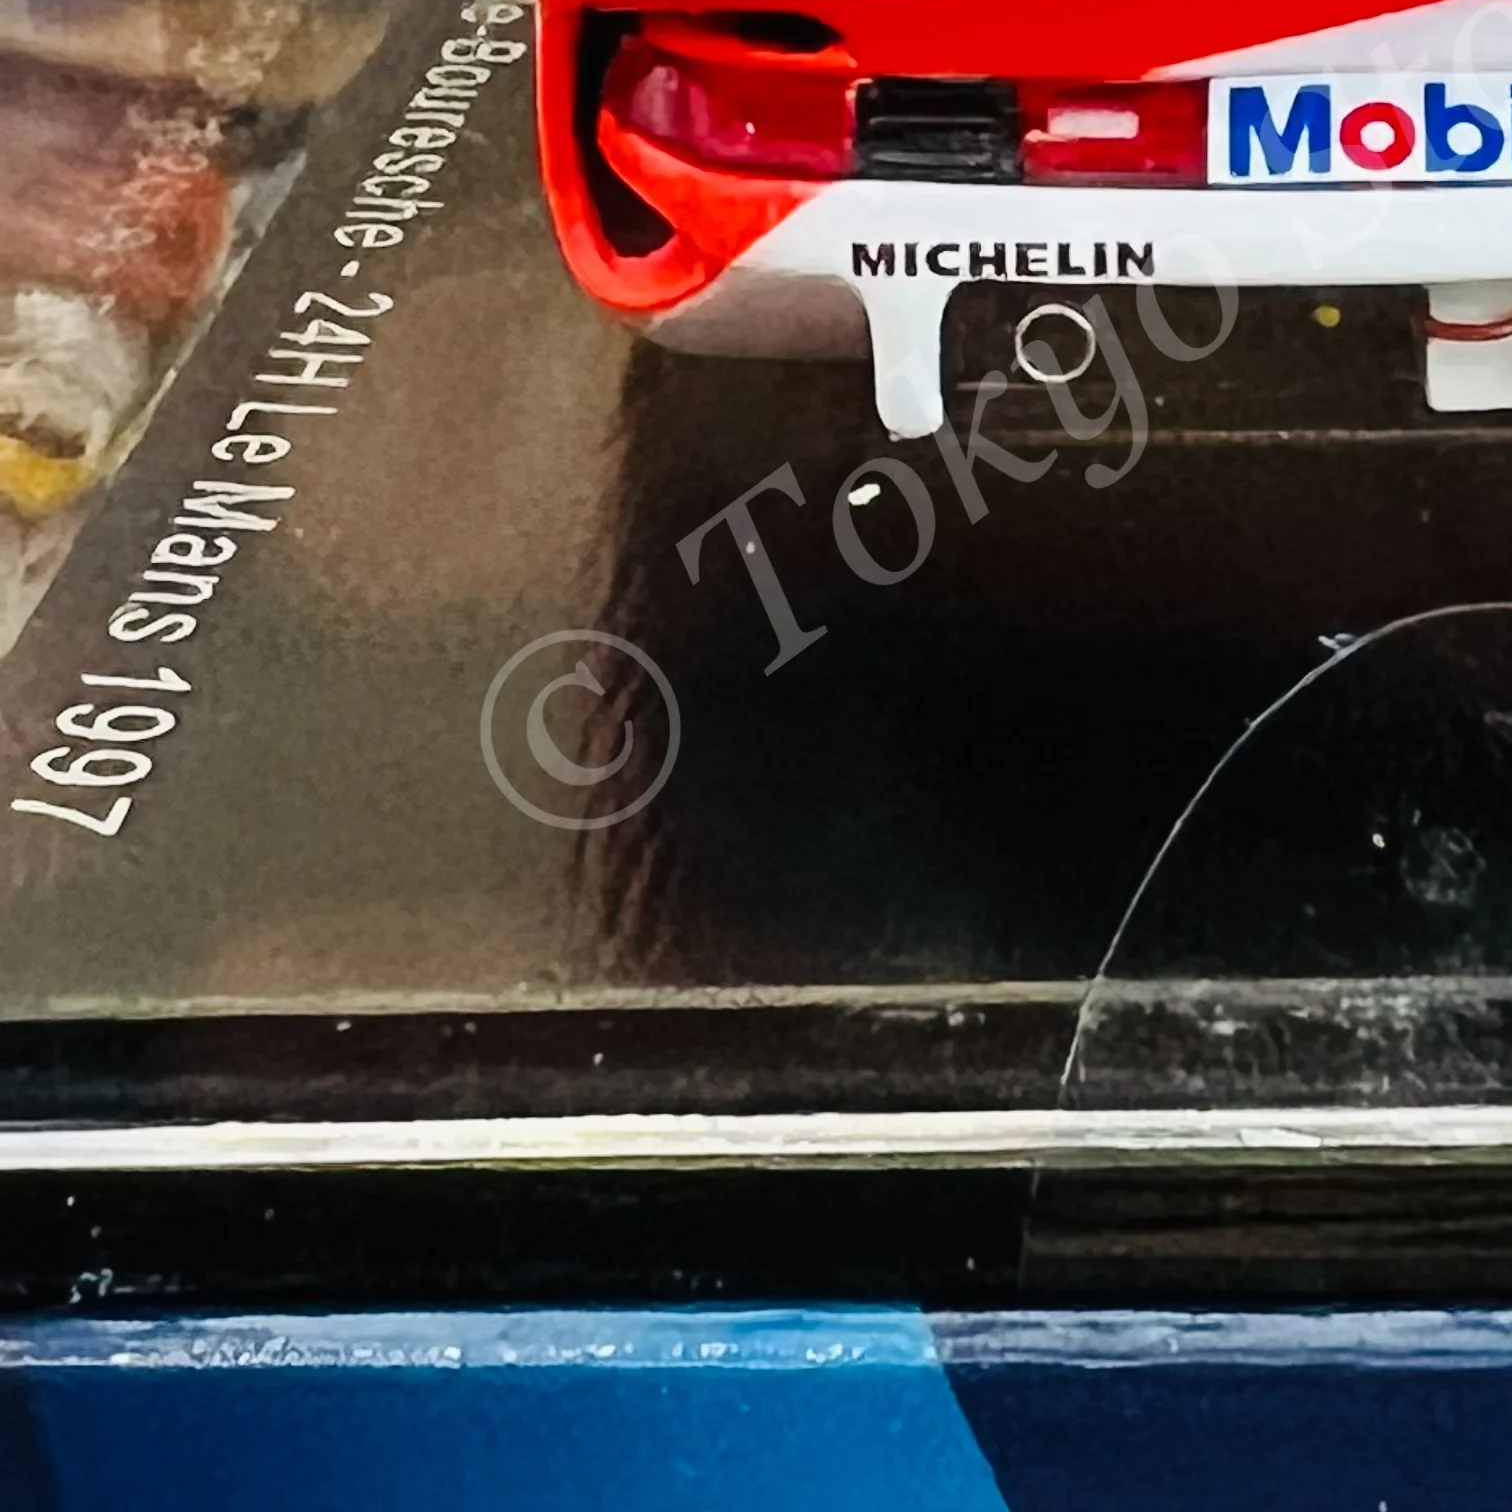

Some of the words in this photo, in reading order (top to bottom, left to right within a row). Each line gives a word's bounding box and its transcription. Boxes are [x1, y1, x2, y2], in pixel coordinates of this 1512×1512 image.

[852, 242, 1156, 278] MICHELIN
[254, 290, 394, 390] 24H
[211, 402, 338, 464] Le
[107, 479, 295, 644] Mans
[10, 672, 192, 836] 1997
